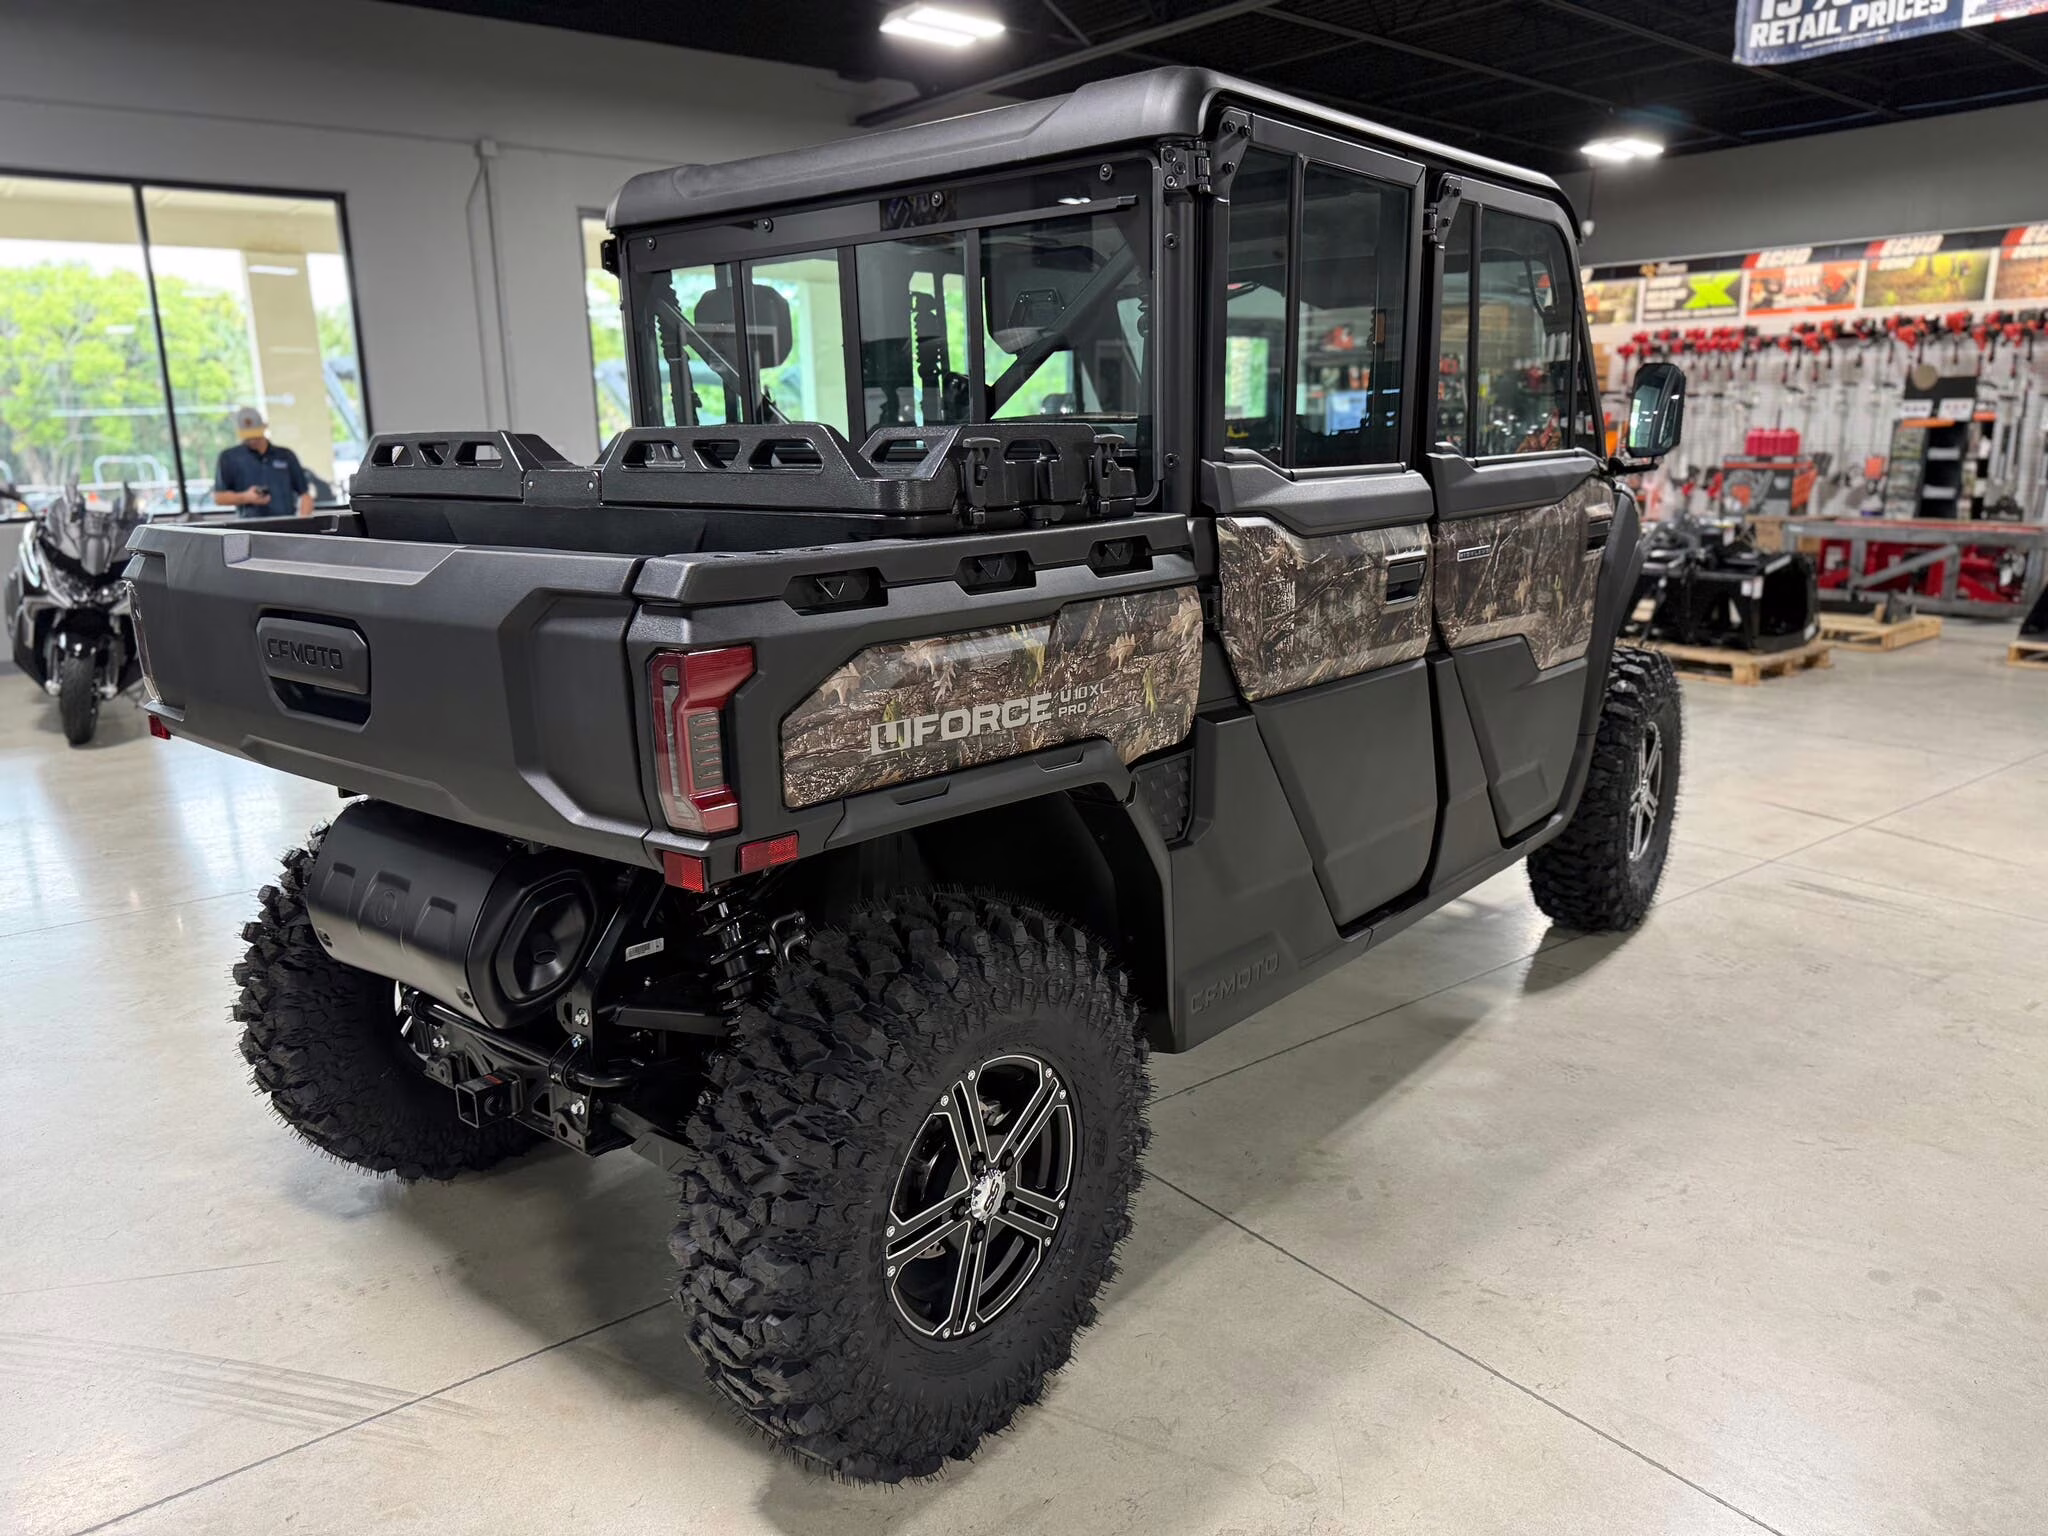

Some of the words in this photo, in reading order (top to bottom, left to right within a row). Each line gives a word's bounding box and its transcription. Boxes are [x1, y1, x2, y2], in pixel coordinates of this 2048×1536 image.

[1750, 8, 1842, 48] RETAIL
[1849, 0, 1948, 32] PRICES
[267, 638, 343, 670] CFMOTO
[1058, 702, 1087, 718] PRO
[1191, 952, 1280, 1015] CFMOTO
